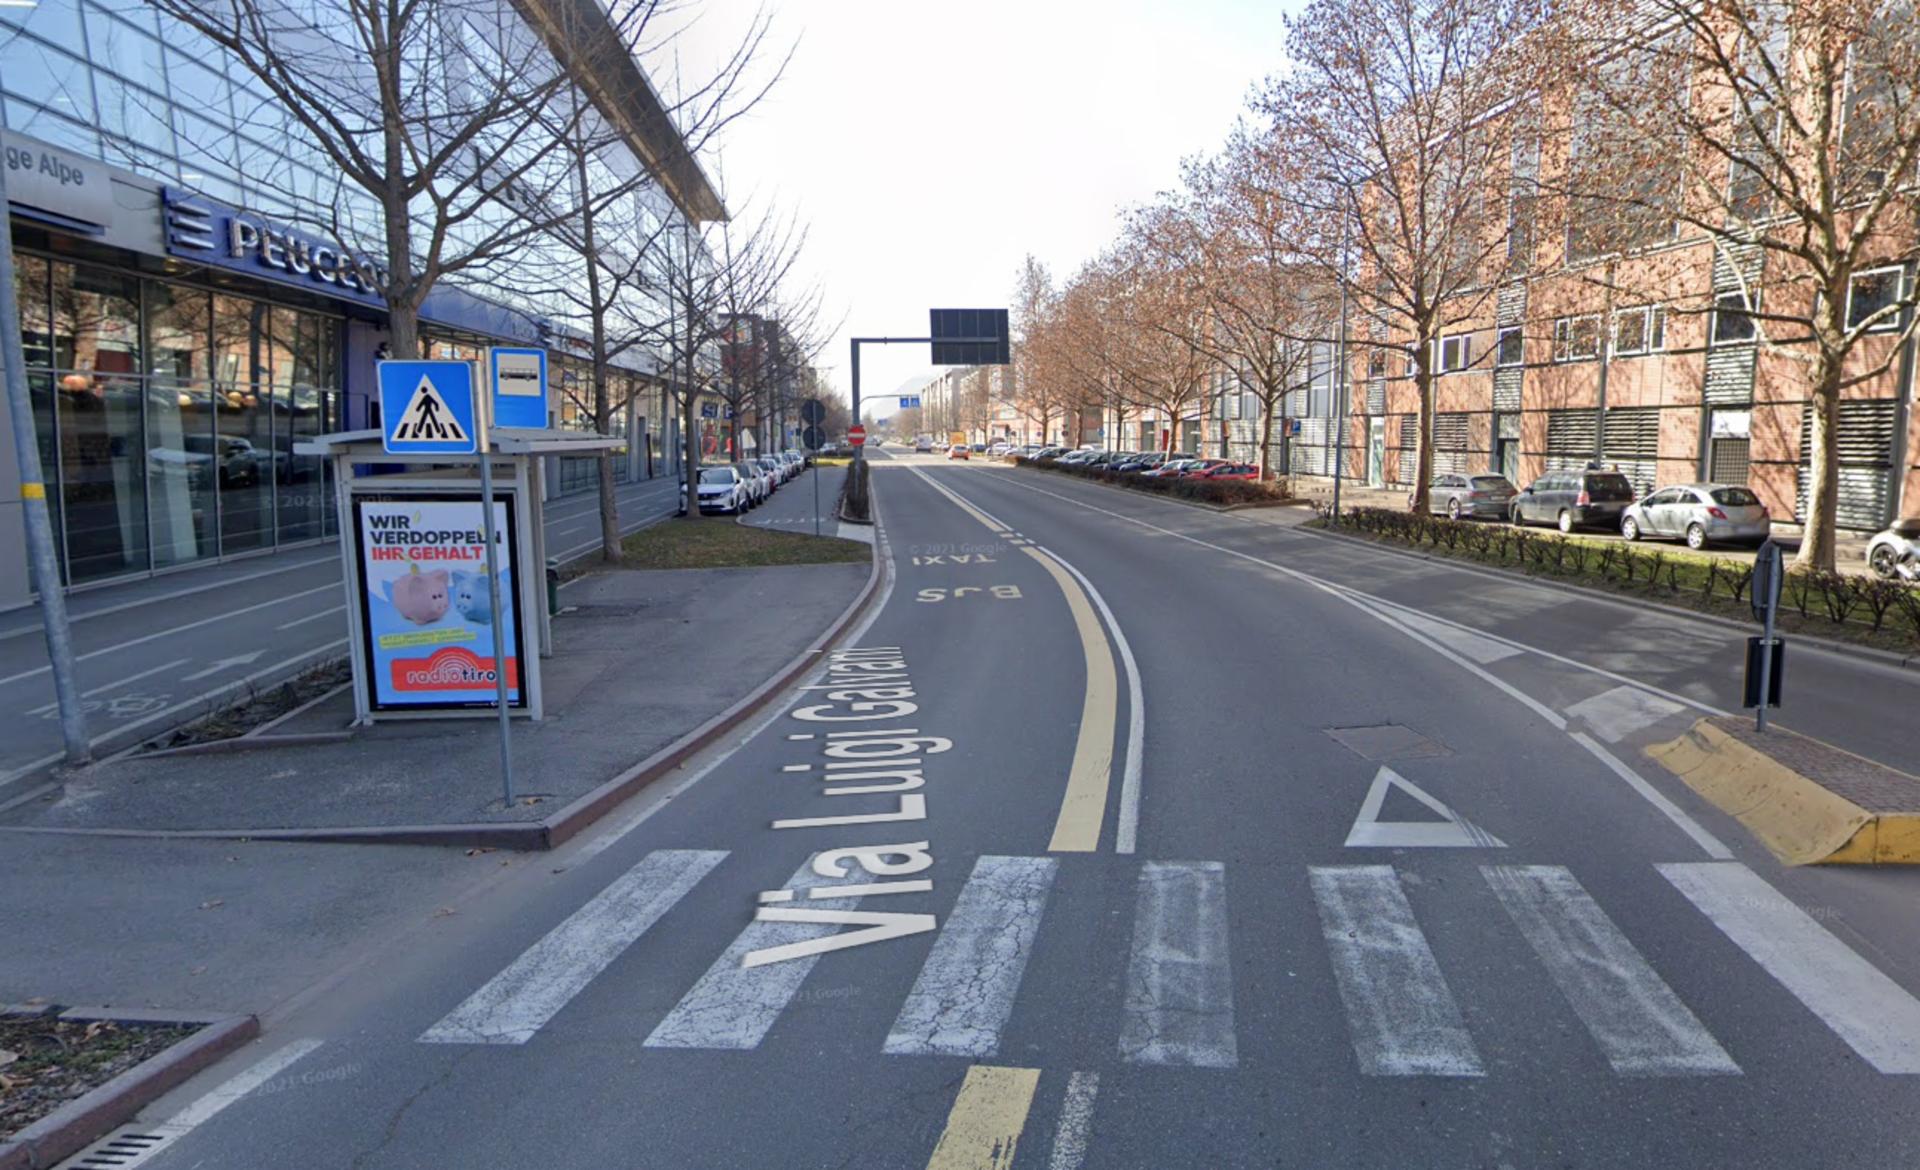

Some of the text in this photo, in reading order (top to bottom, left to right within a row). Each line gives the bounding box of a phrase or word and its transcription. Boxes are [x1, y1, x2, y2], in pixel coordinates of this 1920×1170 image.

[6, 146, 85, 187] ge Alpe
[369, 514, 410, 529] WIR
[371, 545, 484, 561] IHR GEHALT
[912, 554, 998, 566] TAXI
[406, 667, 498, 684] radiotiro
